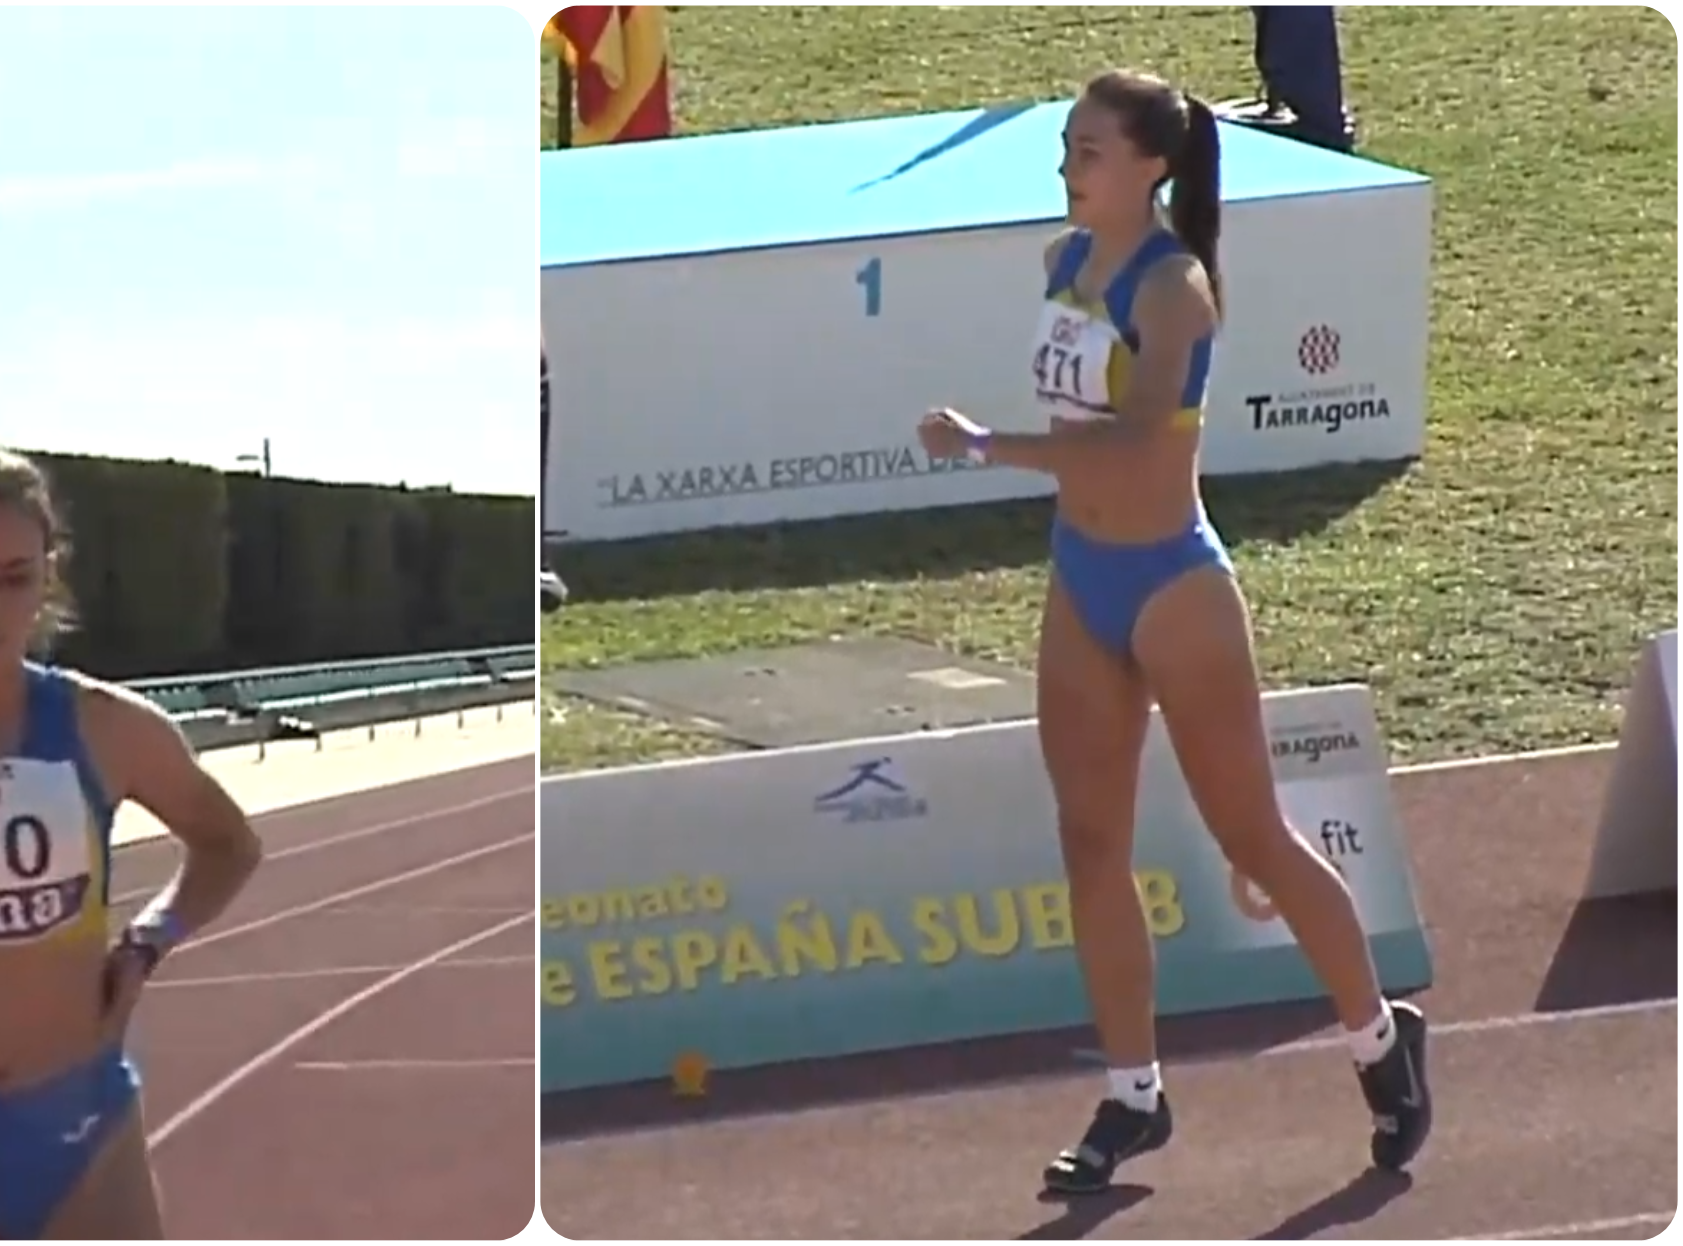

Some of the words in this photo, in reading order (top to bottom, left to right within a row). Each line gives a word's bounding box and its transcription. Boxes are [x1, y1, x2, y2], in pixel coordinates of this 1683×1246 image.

[856, 257, 881, 317] 1
[1032, 342, 1083, 398] 471
[655, 462, 758, 500] XARXA
[769, 446, 916, 489] ESPORTIVA
[1320, 819, 1364, 856] fit
[588, 899, 904, 1000] ESPAÑA
